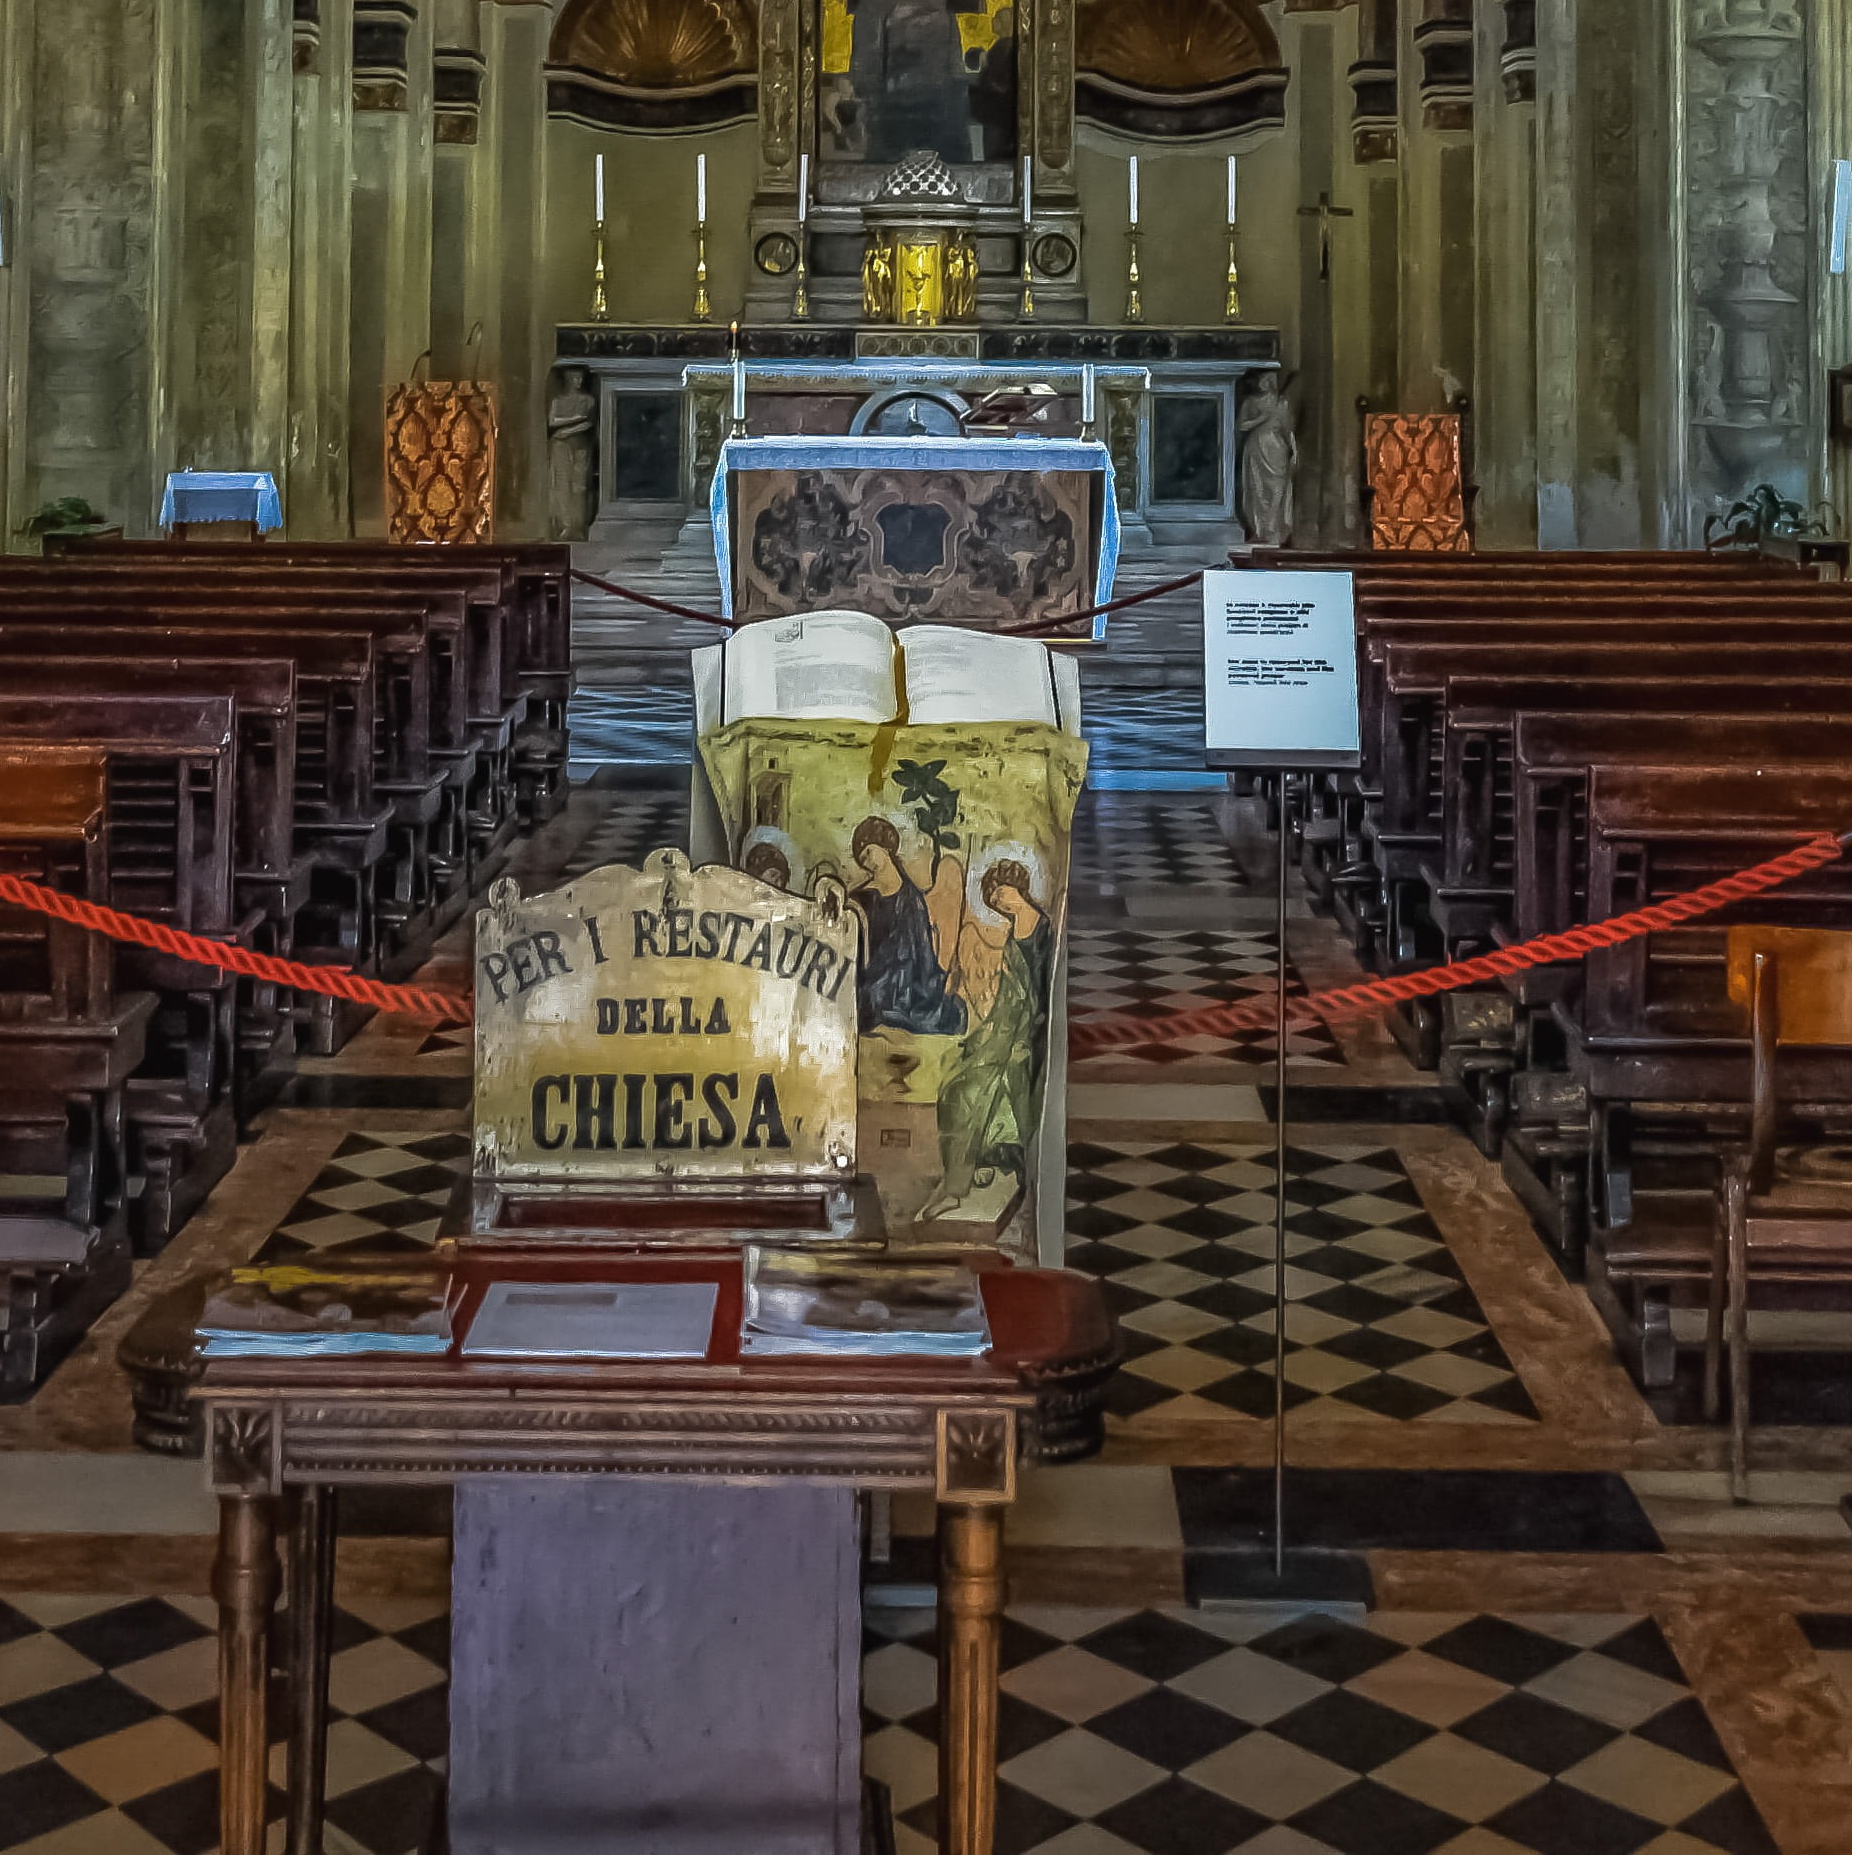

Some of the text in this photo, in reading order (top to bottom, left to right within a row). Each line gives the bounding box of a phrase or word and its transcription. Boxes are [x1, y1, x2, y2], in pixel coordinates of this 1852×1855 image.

[482, 909, 854, 1005] PER I RESTAURI
[596, 996, 731, 1035] DELLA
[531, 1072, 790, 1150] CHIESA
